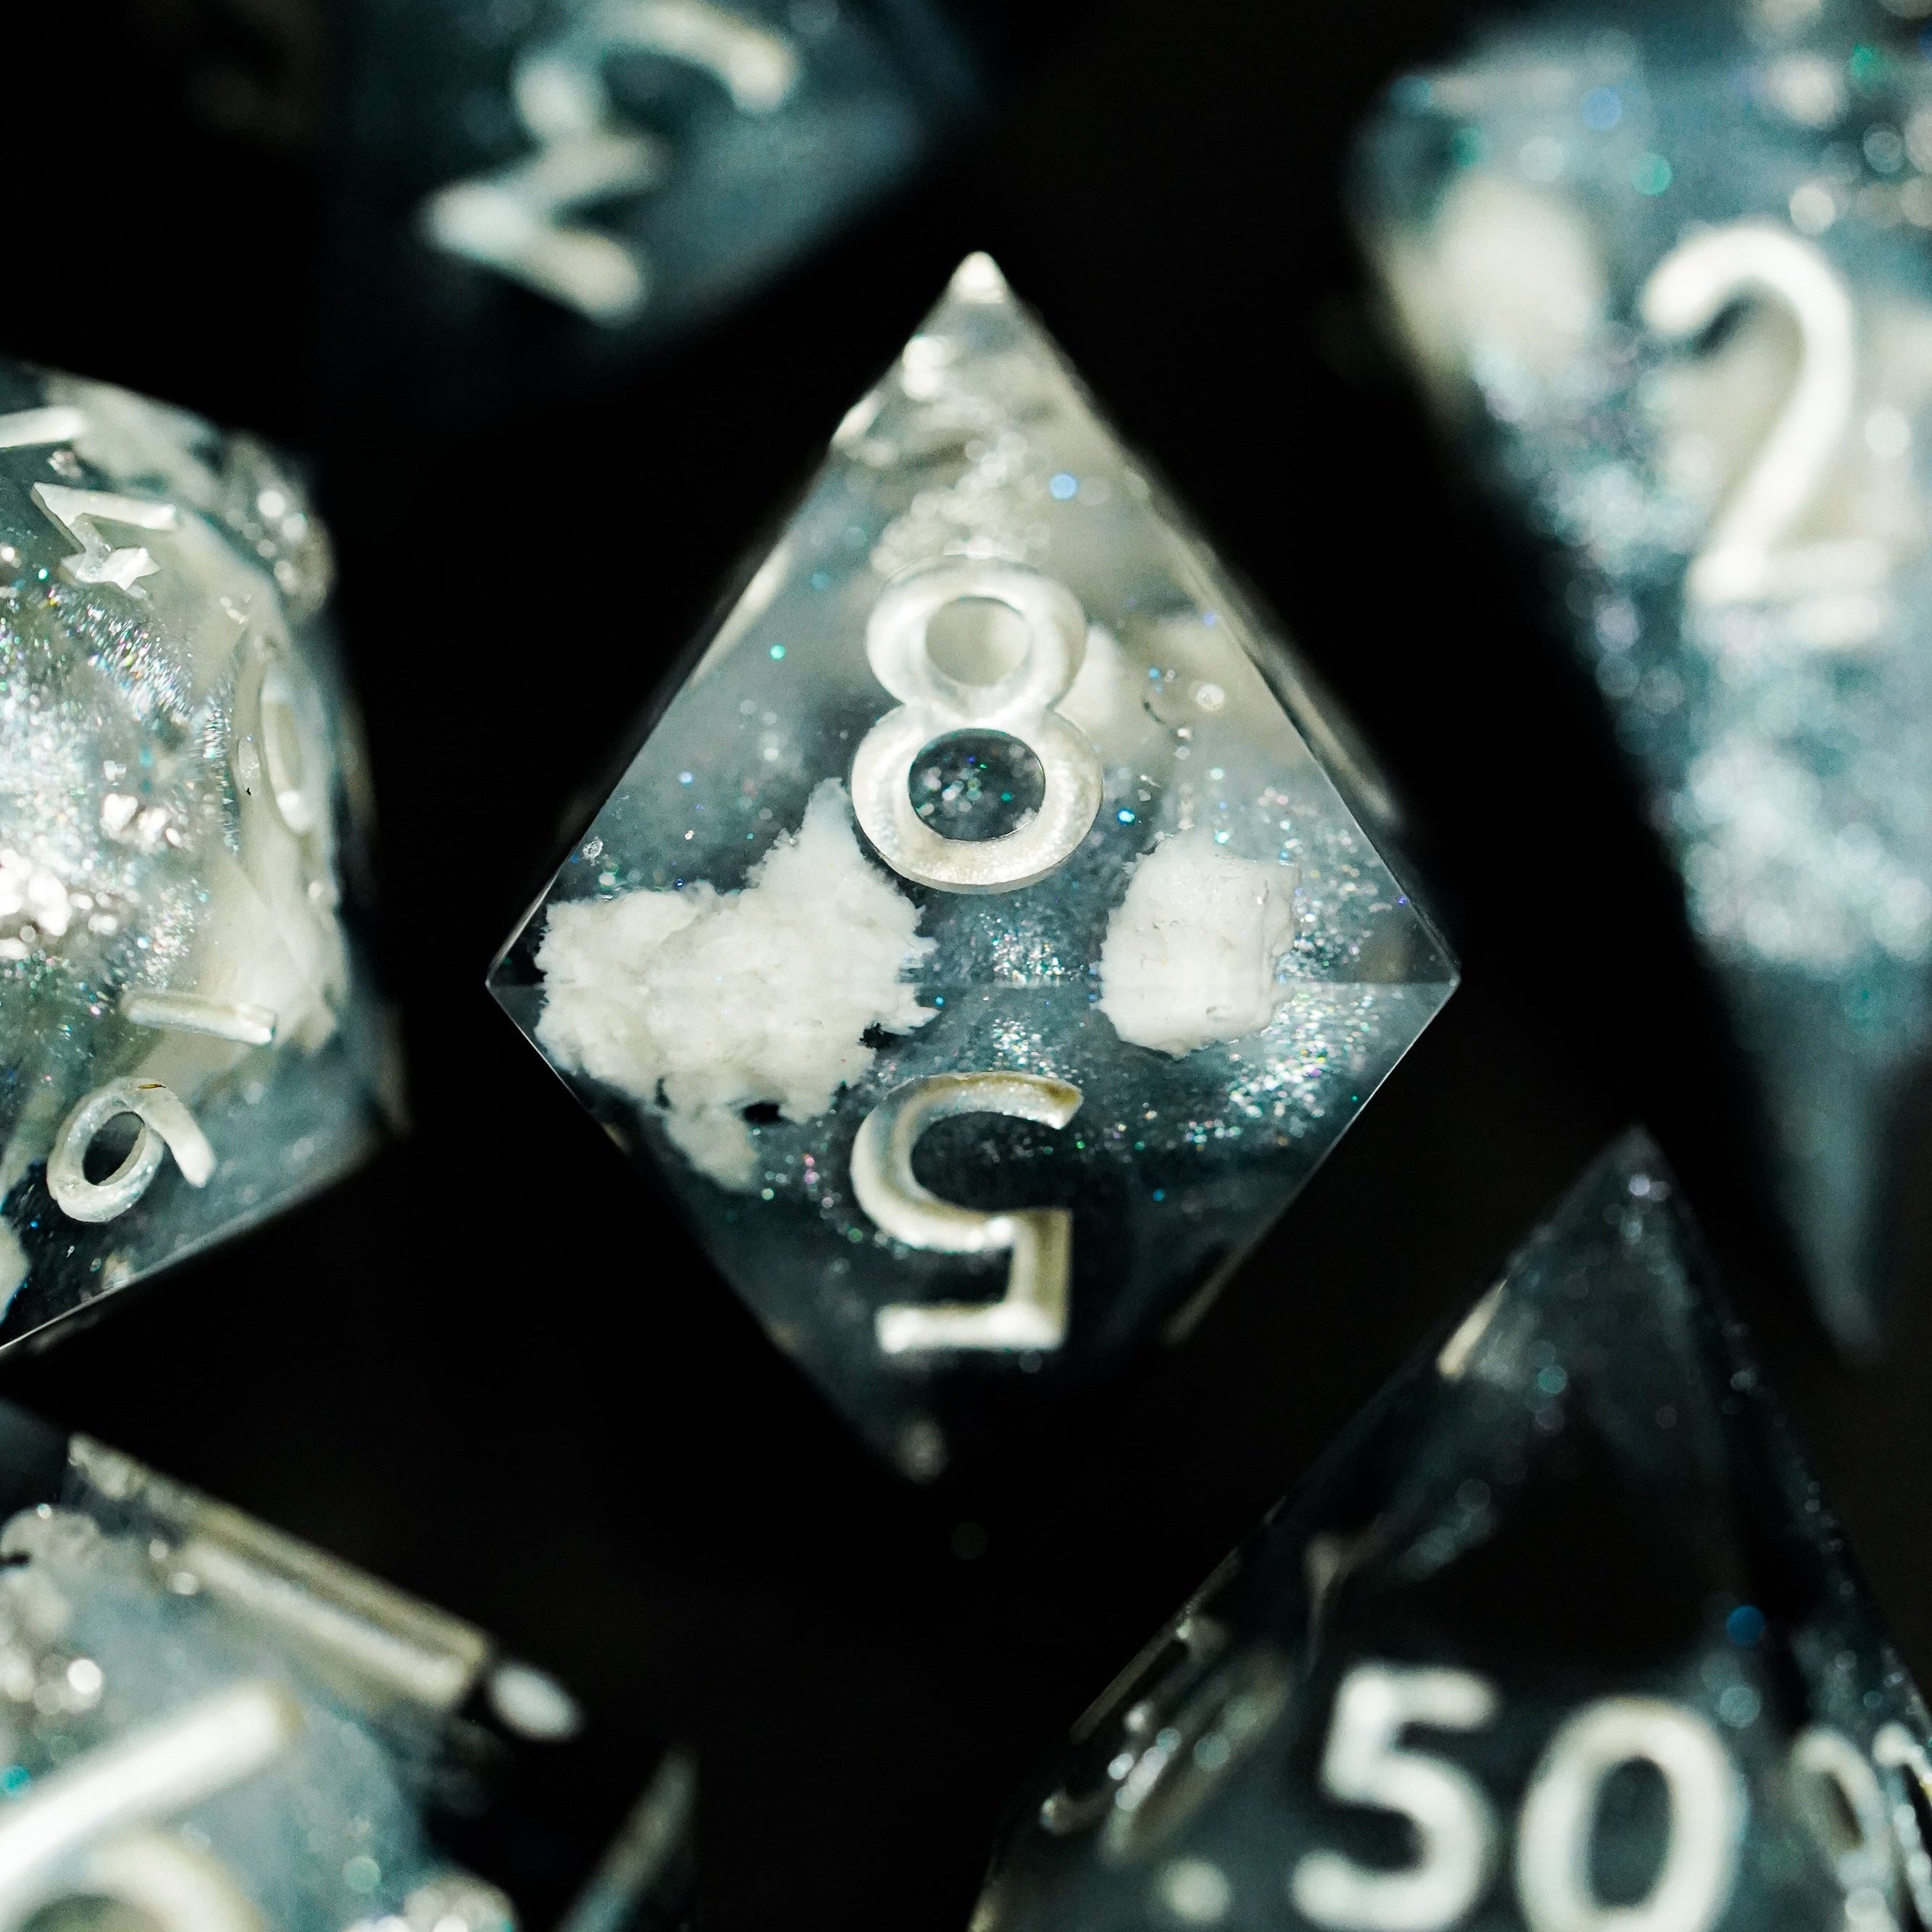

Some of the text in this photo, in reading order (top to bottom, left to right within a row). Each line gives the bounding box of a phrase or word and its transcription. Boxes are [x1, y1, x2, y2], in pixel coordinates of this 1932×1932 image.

[420, 0, 793, 322] 3
[1642, 221, 1889, 607] 2
[851, 553, 1103, 894] 8
[850, 1071, 1084, 1352] 5
[1293, 1663, 1747, 1932] 50
